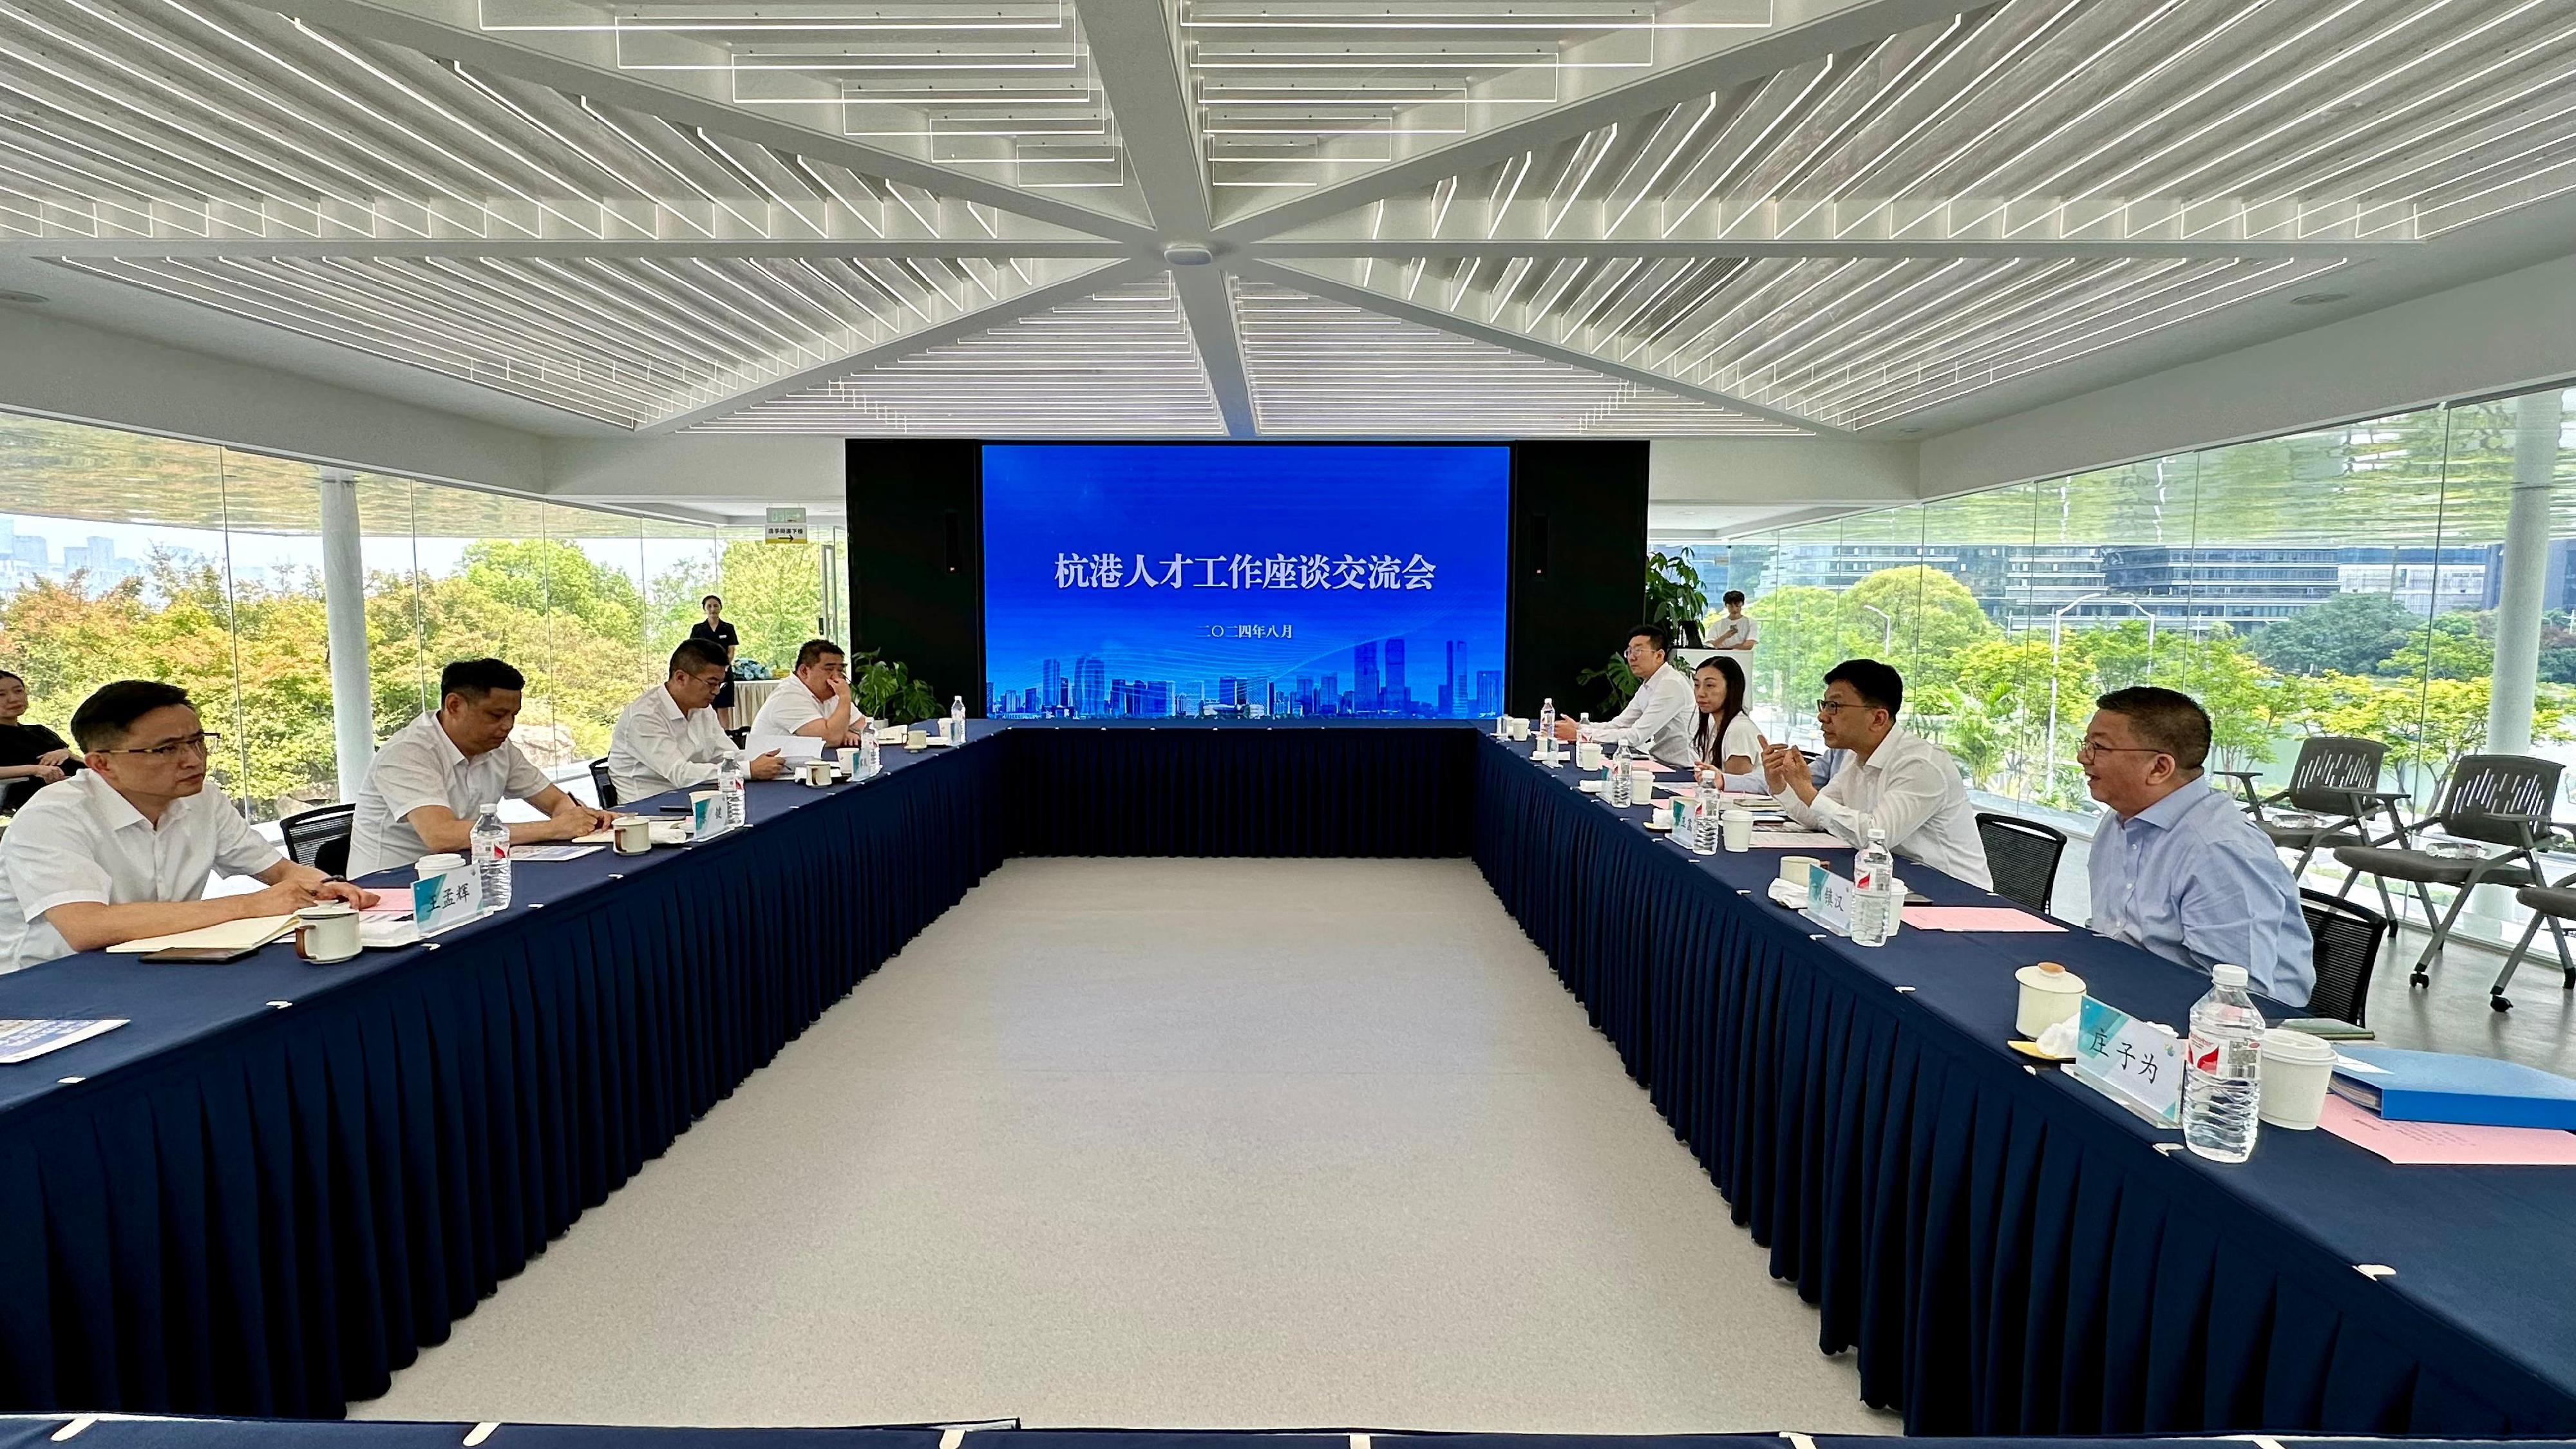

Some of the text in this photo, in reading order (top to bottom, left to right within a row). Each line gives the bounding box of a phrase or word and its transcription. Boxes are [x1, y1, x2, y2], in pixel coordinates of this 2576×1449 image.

[1054, 553, 1436, 590] 杭港人才工作座谈交流会
[427, 882, 469, 913] 王孟辉
[2089, 1028, 2158, 1084] 庄子为
